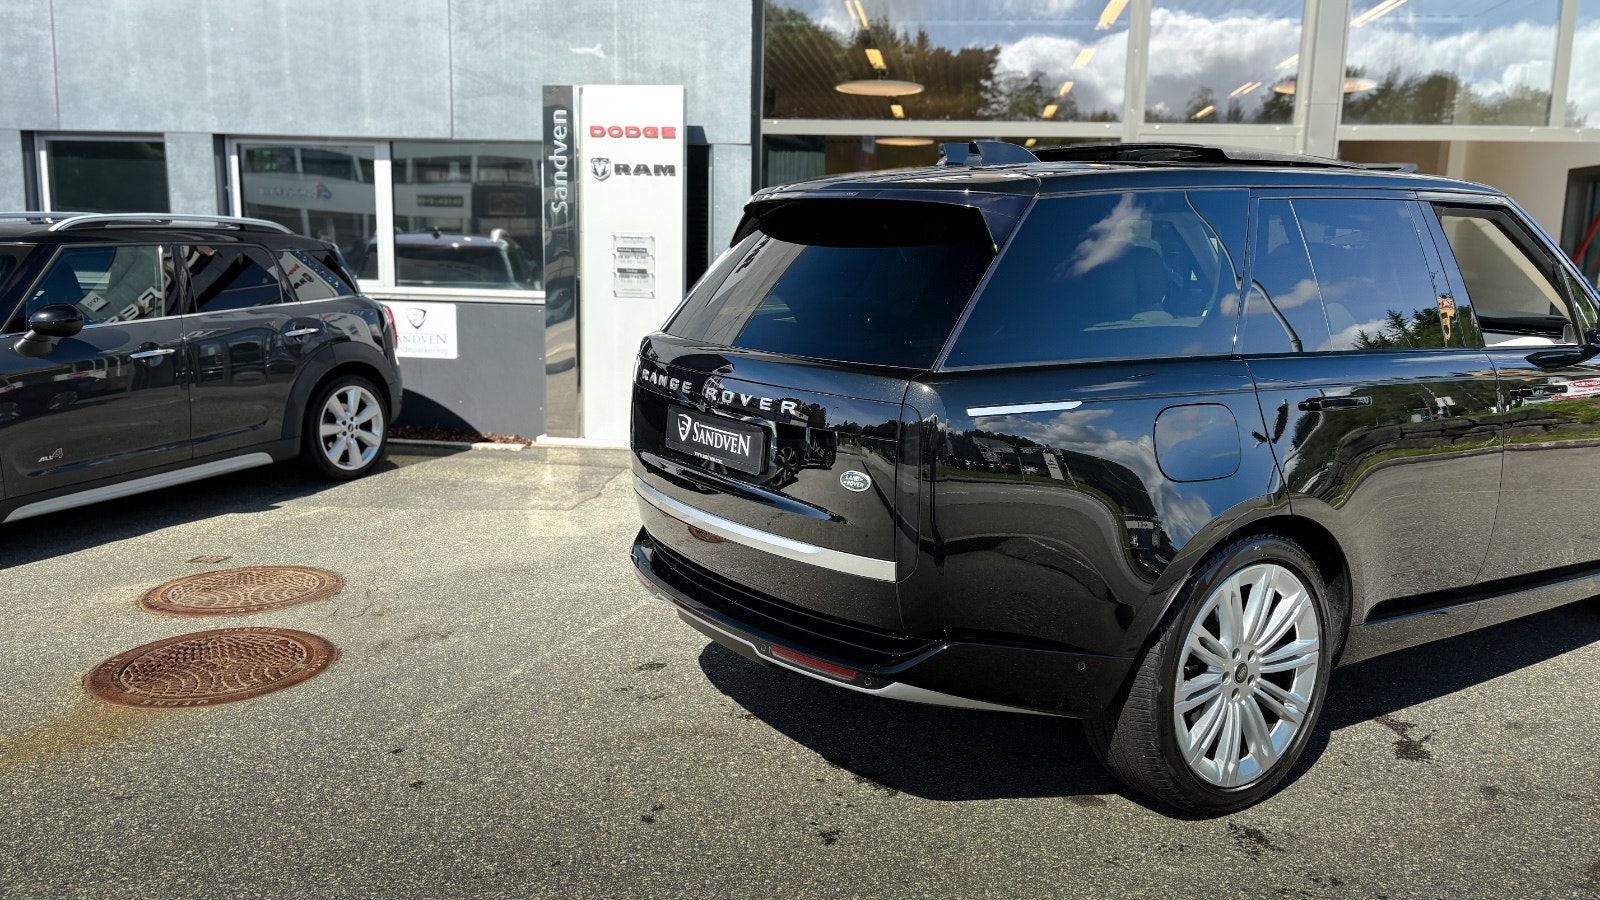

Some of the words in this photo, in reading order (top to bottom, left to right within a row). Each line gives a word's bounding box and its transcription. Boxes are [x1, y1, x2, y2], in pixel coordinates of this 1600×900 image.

[589, 125, 677, 139] DODGE
[548, 109, 568, 214] Sandven
[614, 163, 676, 177] RAM
[398, 332, 447, 344] NDVEN
[641, 368, 692, 394] RANGE
[704, 387, 798, 415] ROVER
